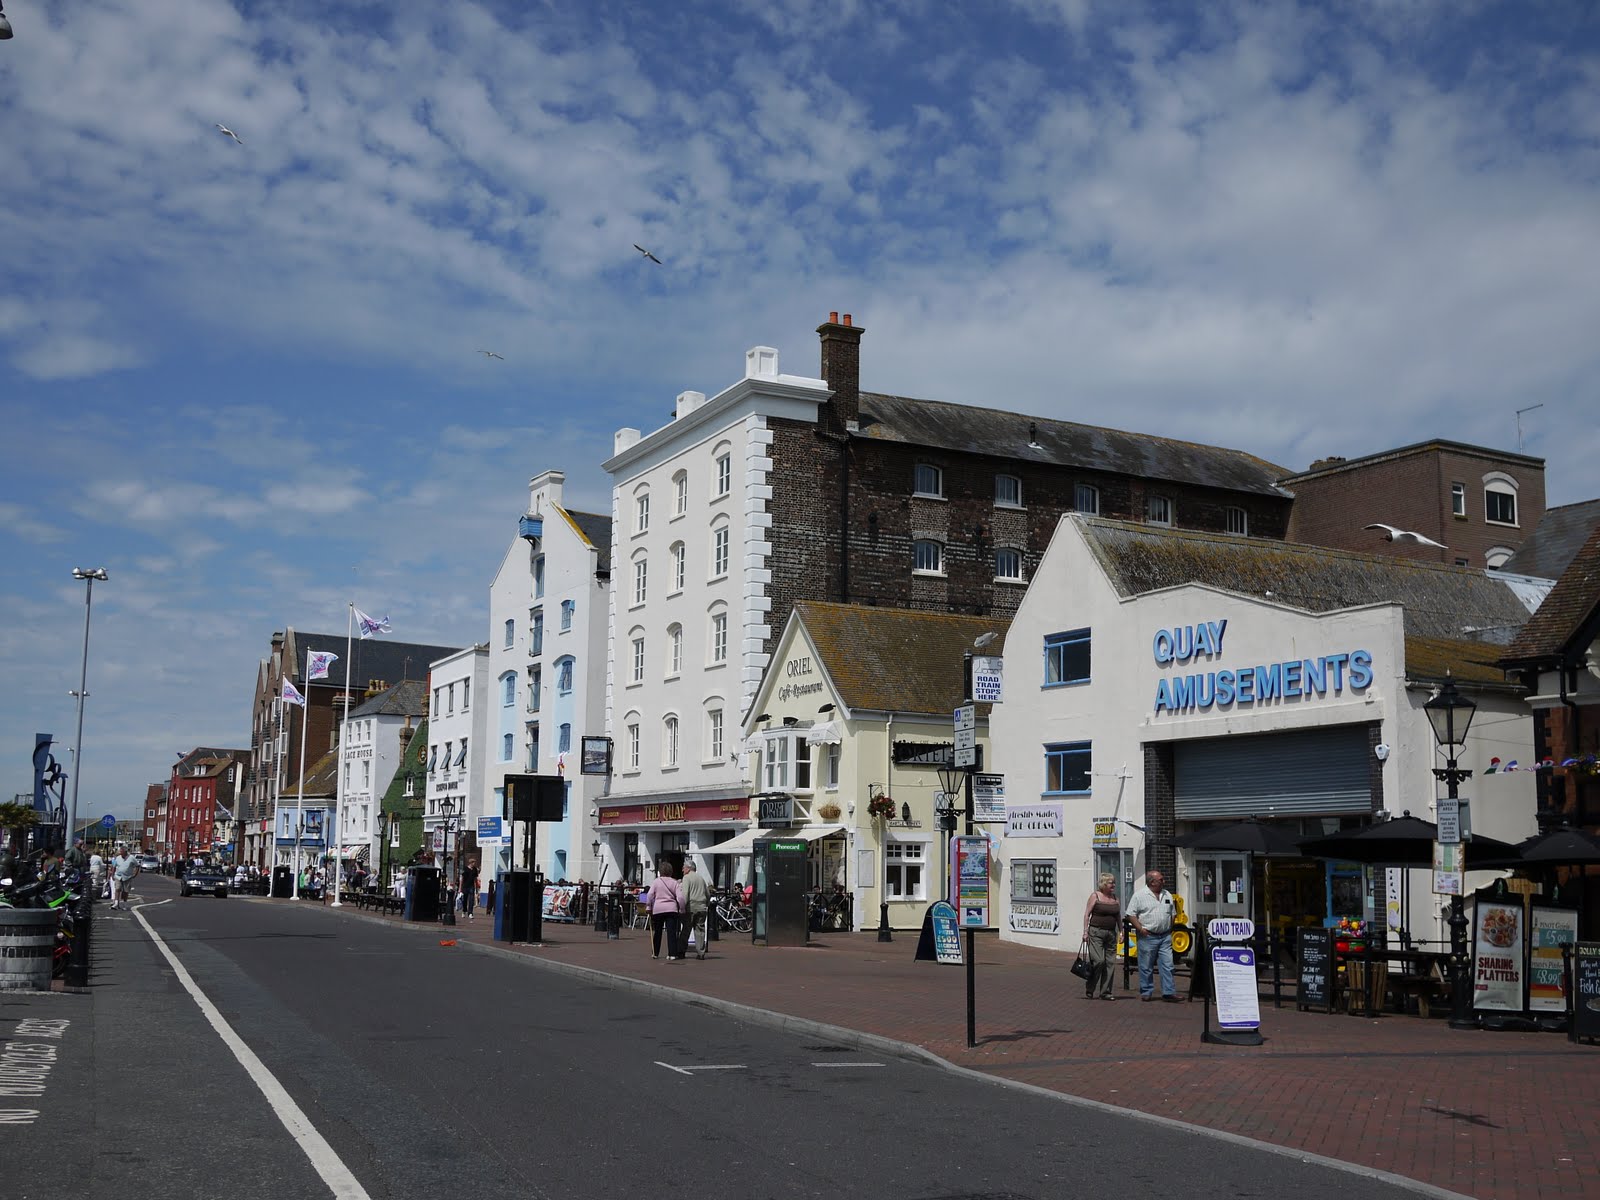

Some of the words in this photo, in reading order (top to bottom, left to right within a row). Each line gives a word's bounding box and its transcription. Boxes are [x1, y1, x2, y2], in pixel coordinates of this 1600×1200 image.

[1153, 620, 1227, 663] QUAY
[787, 656, 812, 677] ORIEL
[1154, 650, 1373, 710] AMUSEMENTS
[643, 805, 660, 821] THE
[663, 803, 686, 821] QUAY
[761, 801, 788, 819] ORIEL
[1011, 905, 1037, 915] FRESHLY
[1037, 906, 1058, 916] MADE
[1017, 918, 1052, 930] ICE-CREAM
[1211, 922, 1230, 935] LAND
[1231, 922, 1251, 935] TRAIN
[1579, 947, 1597, 955] JOLLY
[1479, 957, 1513, 970] SHARING
[1478, 969, 1520, 982] PLATTERS
[1537, 969, 1559, 985] £8.99
[1579, 978, 1595, 994] Fish
